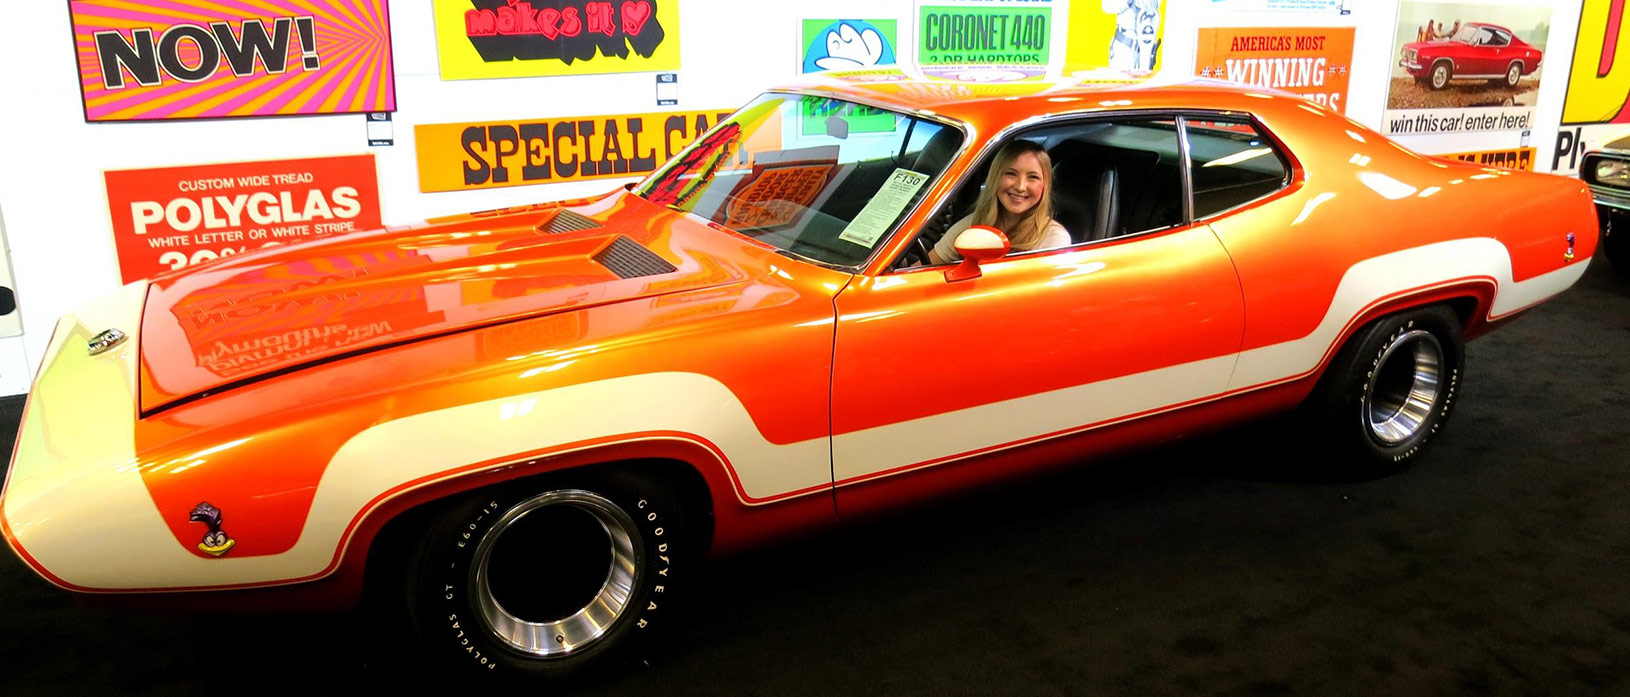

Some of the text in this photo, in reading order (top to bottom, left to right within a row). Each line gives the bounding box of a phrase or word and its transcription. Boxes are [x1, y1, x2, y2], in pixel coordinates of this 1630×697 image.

[464, 2, 617, 40] makes it
[926, 13, 1045, 51] CORONET 440
[94, 15, 321, 89] NOW!
[1230, 35, 1326, 52] AMERICA'S MOST
[1225, 57, 1326, 88] WINNING
[1390, 111, 1531, 133] win this car! enter here!
[461, 117, 656, 186] SPECIAL
[664, 113, 731, 163] CA
[178, 172, 313, 192] CUSTOM WIDE TREAD
[893, 173, 921, 186] F130
[130, 186, 361, 235] POLYGLAS
[147, 221, 355, 248] WHITE LETTER OR WHITE STRIPE
[458, 501, 498, 548] E60-15
[637, 498, 670, 629] GOODYEAR
